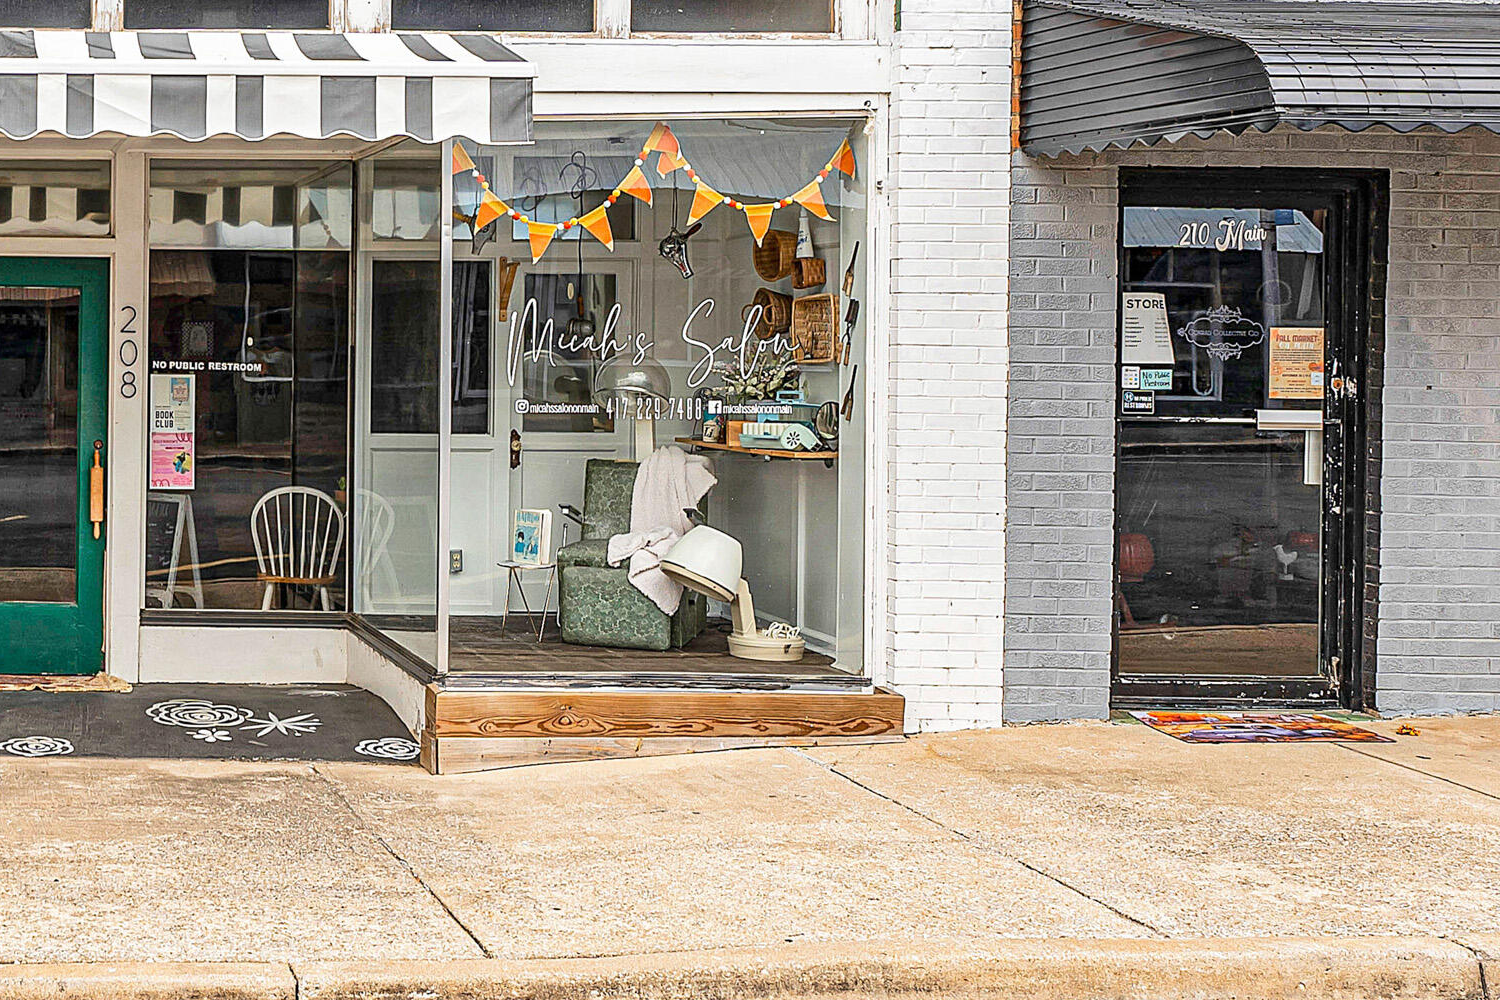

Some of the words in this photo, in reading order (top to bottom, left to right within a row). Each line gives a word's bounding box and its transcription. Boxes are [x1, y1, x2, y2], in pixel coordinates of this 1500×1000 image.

[1179, 222, 1210, 246] 210
[1214, 217, 1268, 252] Main
[1126, 299, 1165, 310] STORE
[506, 297, 655, 388] Micah's
[681, 298, 801, 388] Salon
[119, 305, 139, 399] 208
[152, 360, 167, 369] NO
[168, 360, 205, 370] PUBLIC
[208, 362, 262, 372] RESTROOM
[155, 410, 174, 419] BOOK
[605, 397, 702, 420] 417.229.7488
[155, 420, 174, 429] CLUB
